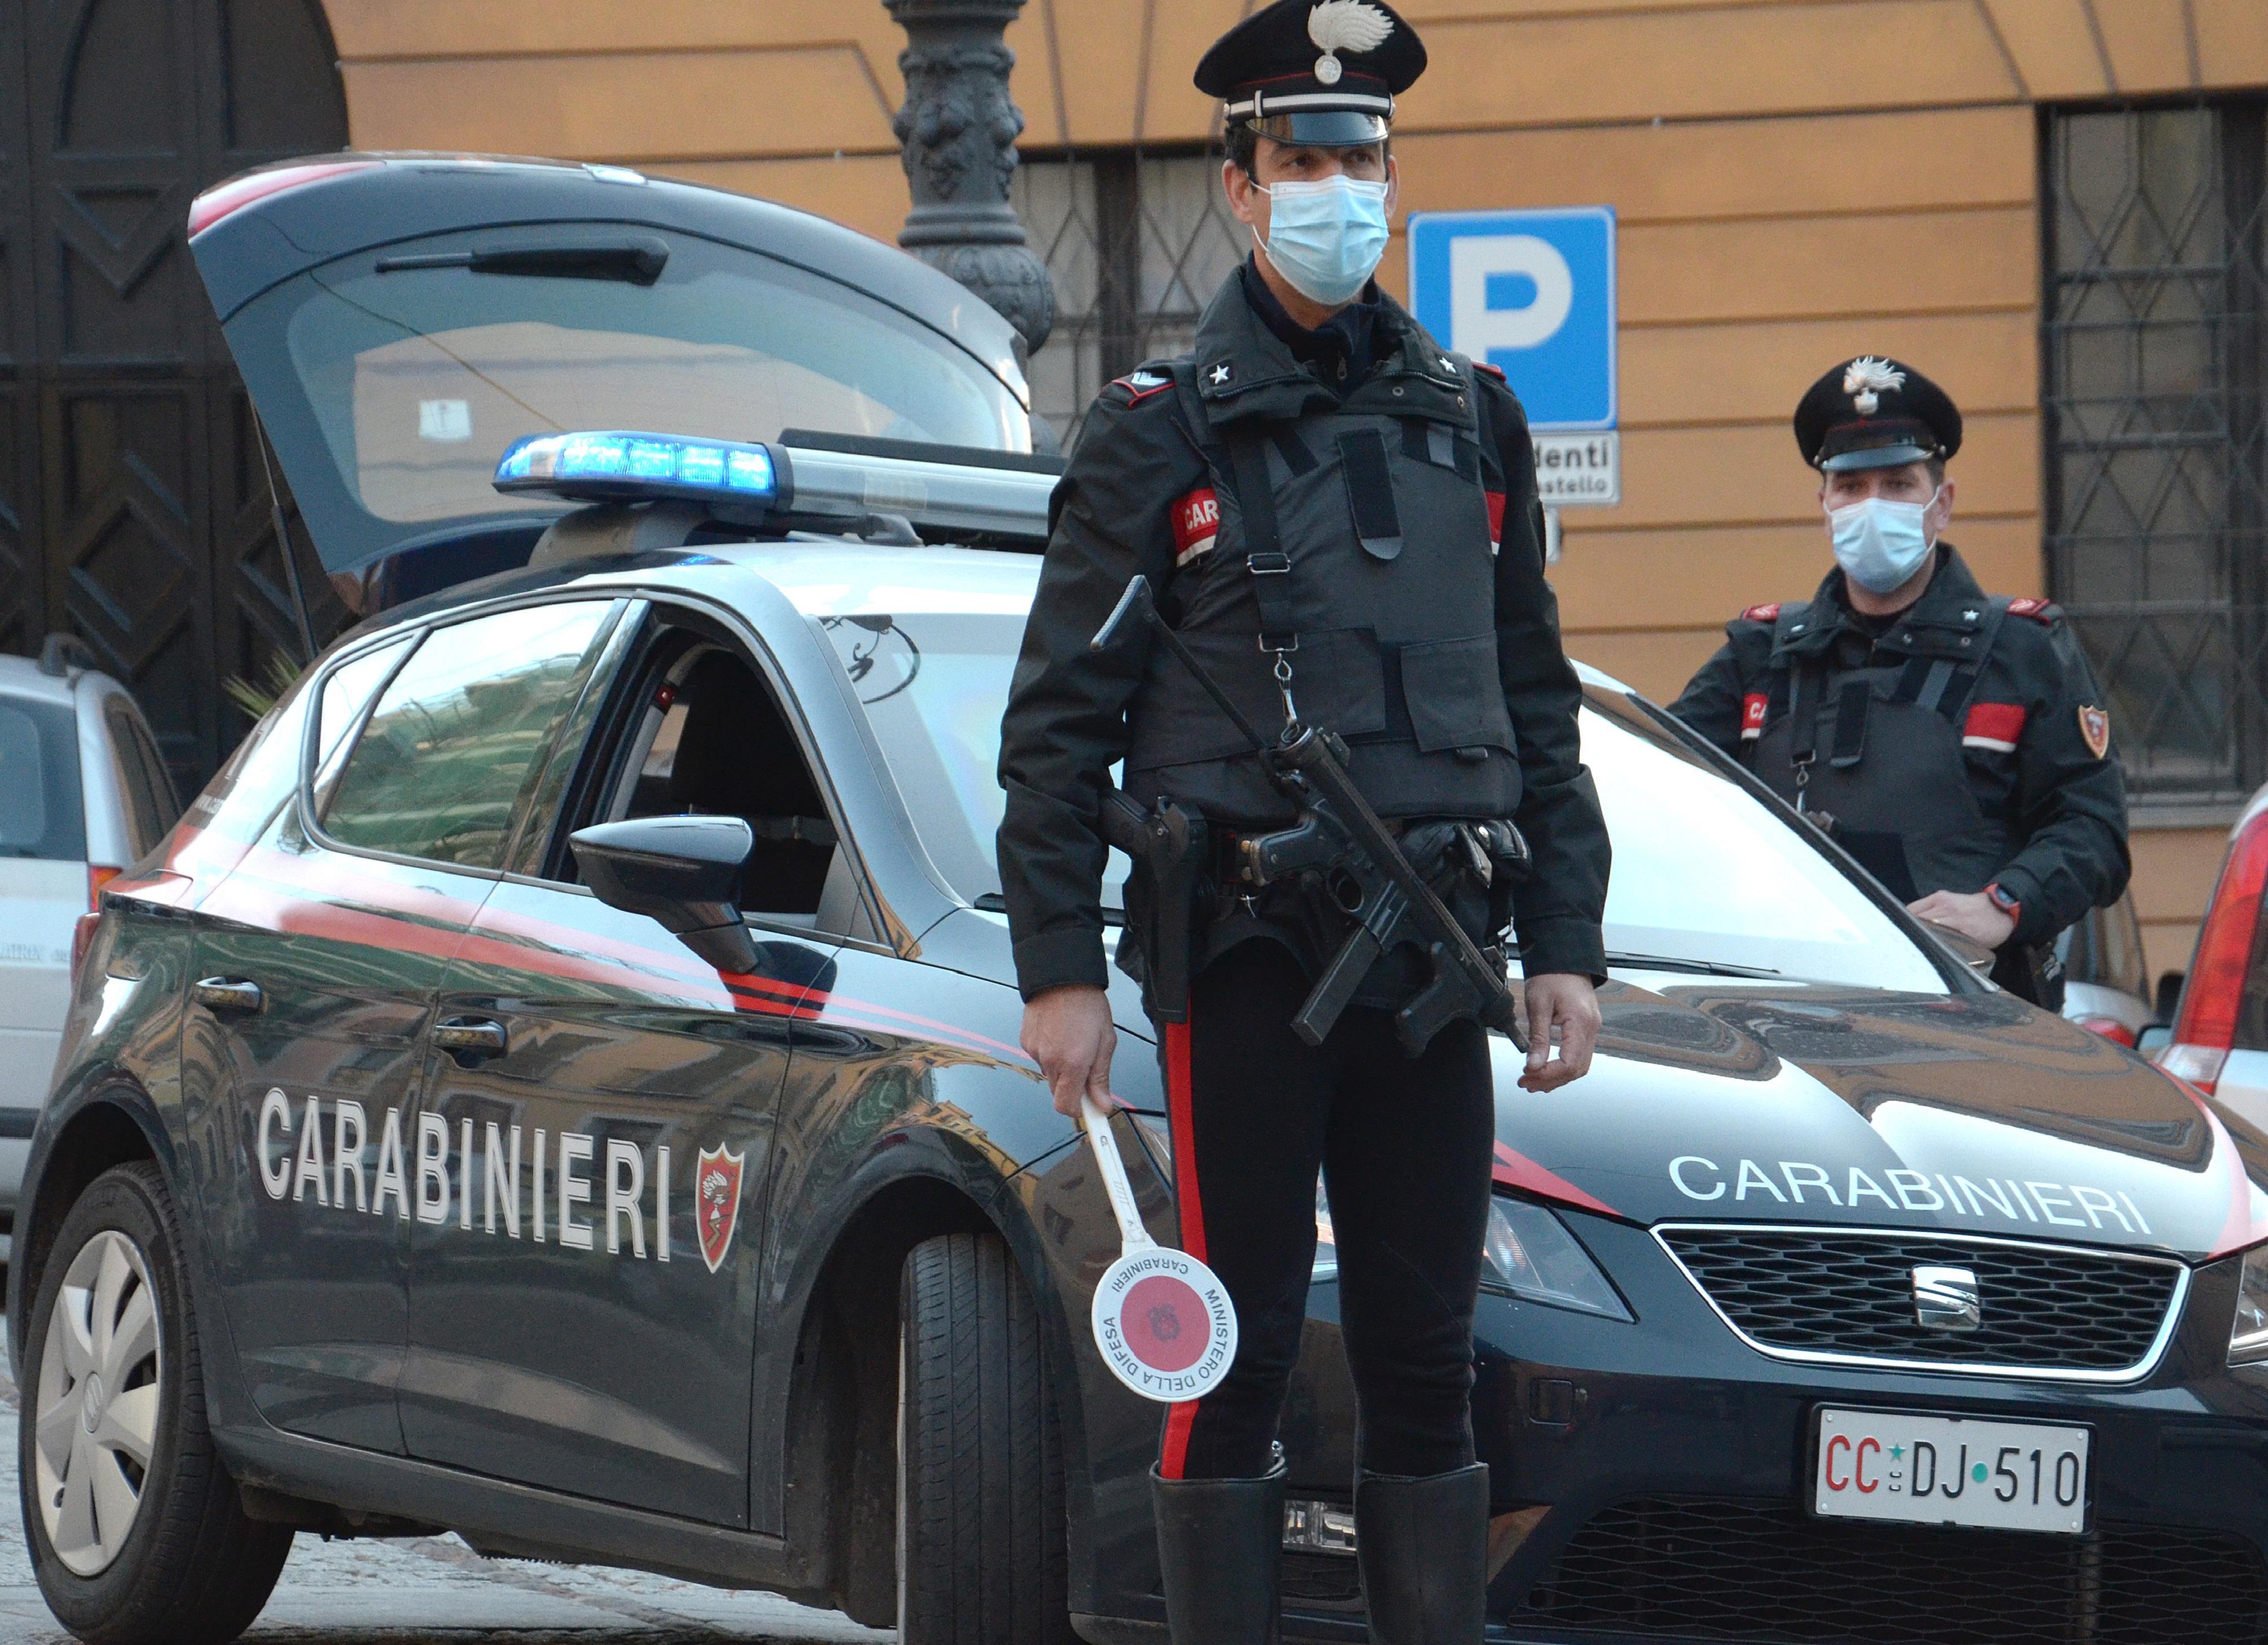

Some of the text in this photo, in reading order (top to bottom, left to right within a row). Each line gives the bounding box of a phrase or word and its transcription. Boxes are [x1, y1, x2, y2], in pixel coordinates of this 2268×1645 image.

[1451, 235, 1573, 364] P
[1185, 500, 1219, 530] CAR
[1537, 475, 1607, 493] stello
[258, 1087, 670, 1263] CARABINIERI
[1668, 1156, 2152, 1235] CARABINIERI
[1112, 1258, 1189, 1293] CARABINIERI
[1103, 1288, 1228, 1391] MINISTERO DELLA DIFESA
